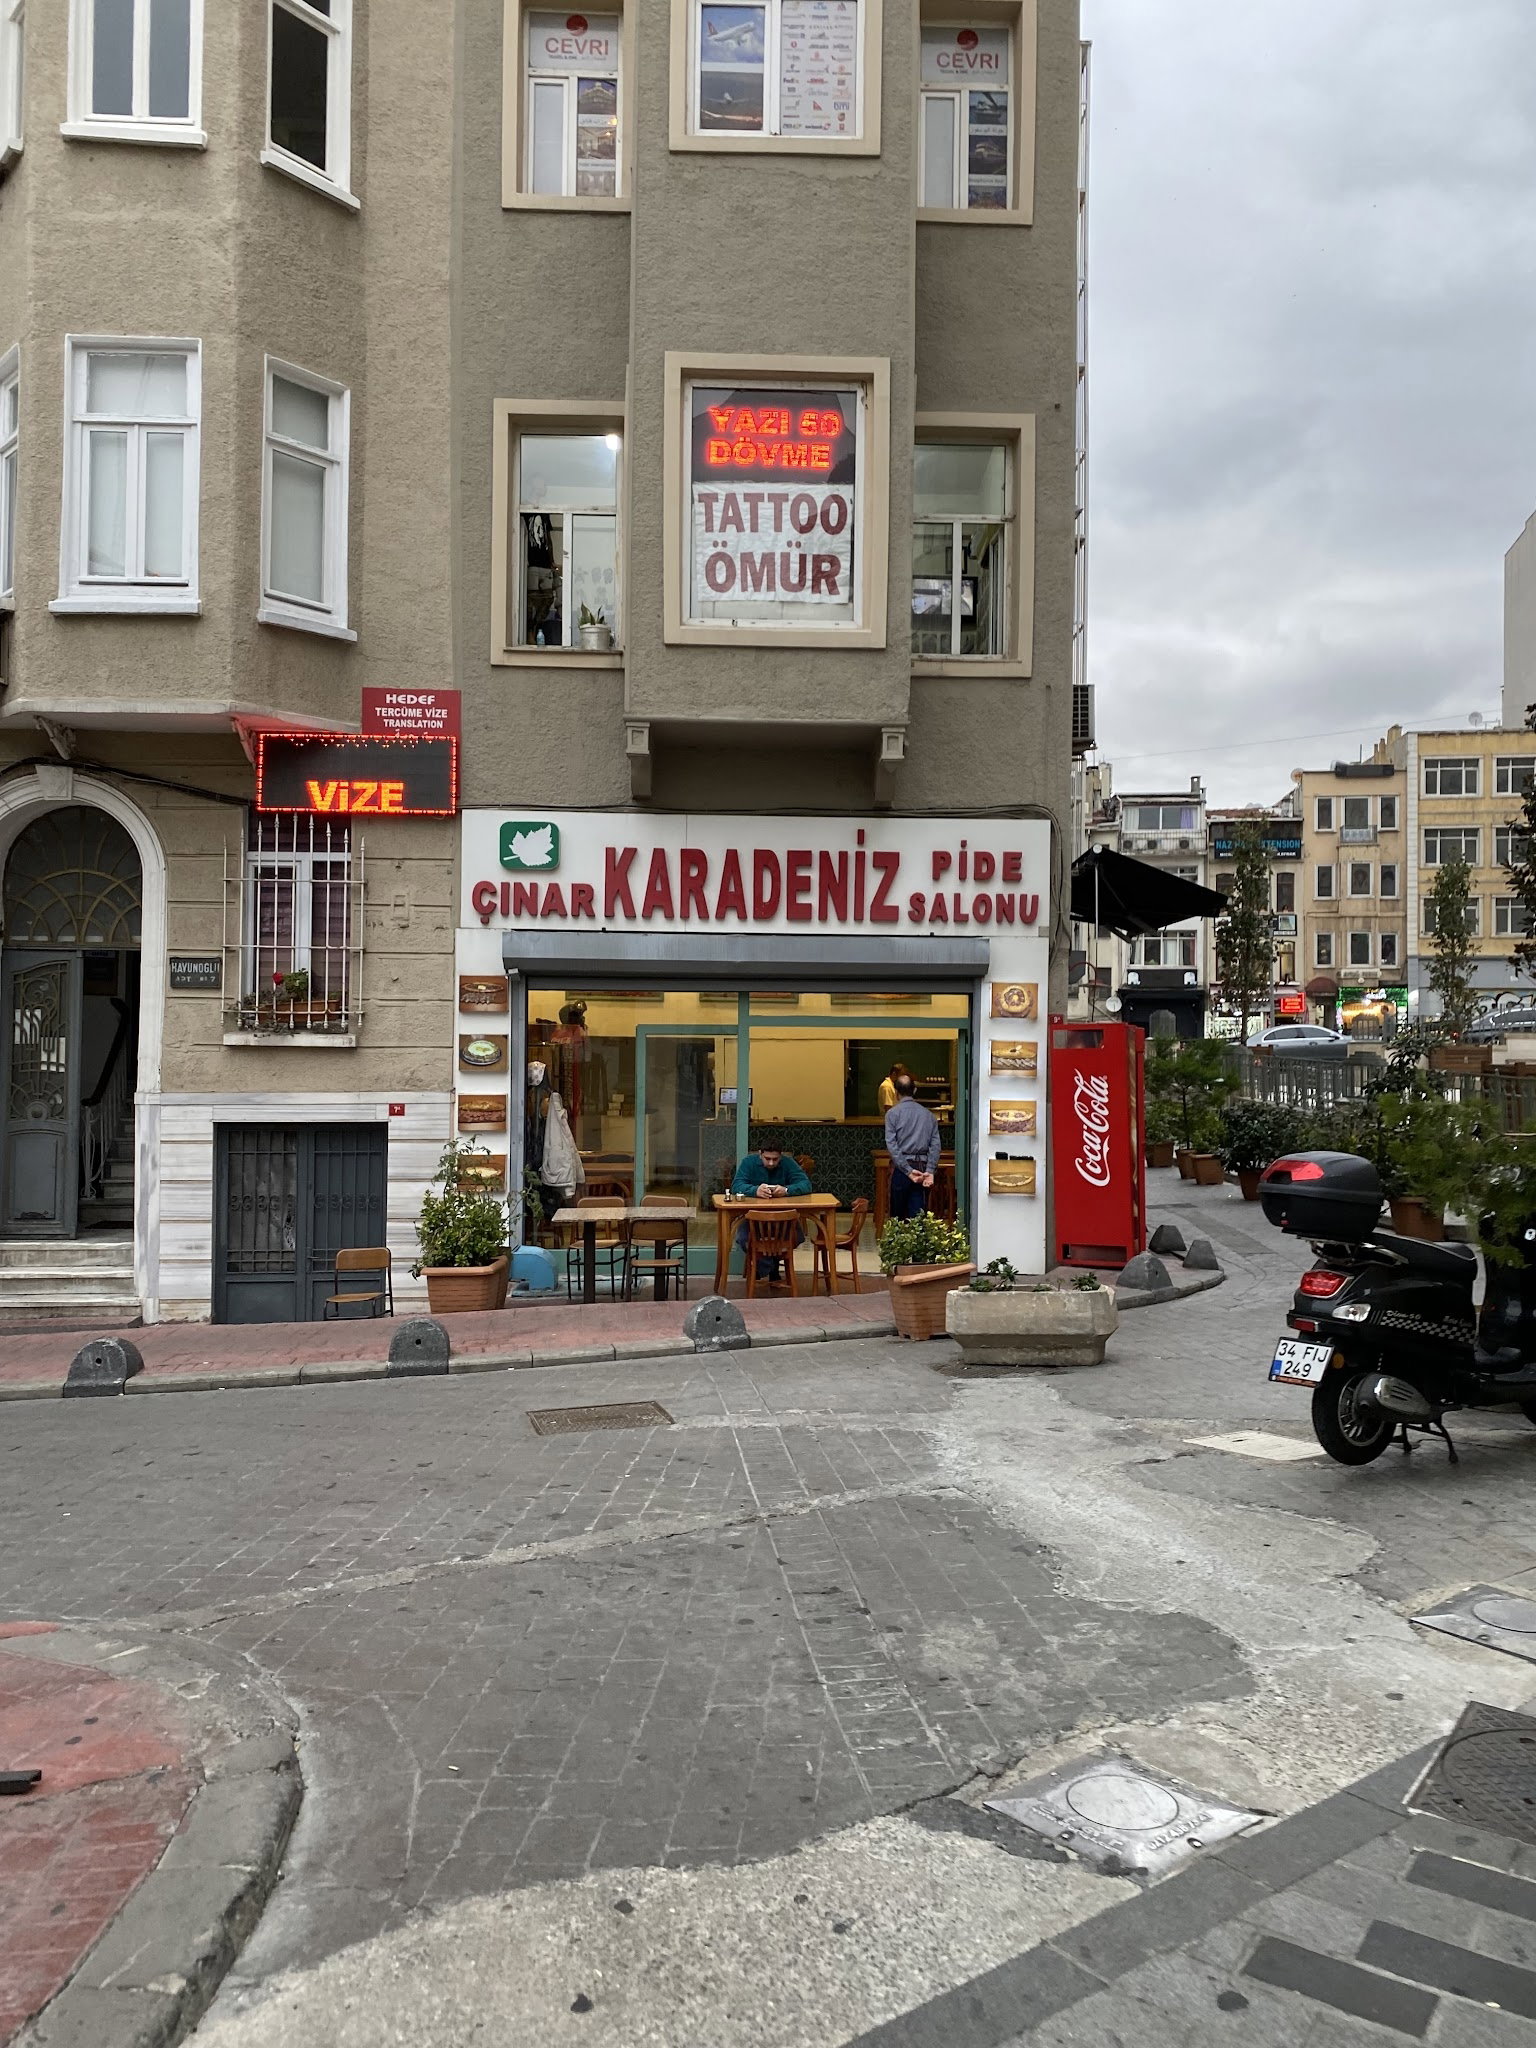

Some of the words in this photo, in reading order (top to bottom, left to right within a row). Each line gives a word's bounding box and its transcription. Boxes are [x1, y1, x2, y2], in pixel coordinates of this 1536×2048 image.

[545, 37, 609, 56] CEVRI
[936, 52, 999, 69] CEVRI
[709, 437, 831, 468] DÖVME
[697, 492, 848, 536] TATTOO
[704, 540, 842, 596] ÖMÜR
[385, 693, 436, 705] HEDEF
[375, 706, 423, 718] TERCÜME
[383, 719, 443, 729] TRANSLATION
[1216, 841, 1232, 849] NAZ
[932, 839, 1023, 881] PİDE
[471, 880, 596, 925] ÇINAR
[604, 829, 900, 922] KARADENİZ
[907, 892, 1040, 925] SALONU
[1279, 1342, 1296, 1357] 34
[1303, 1346, 1329, 1362] FIJ
[1284, 1360, 1312, 1377] 249
